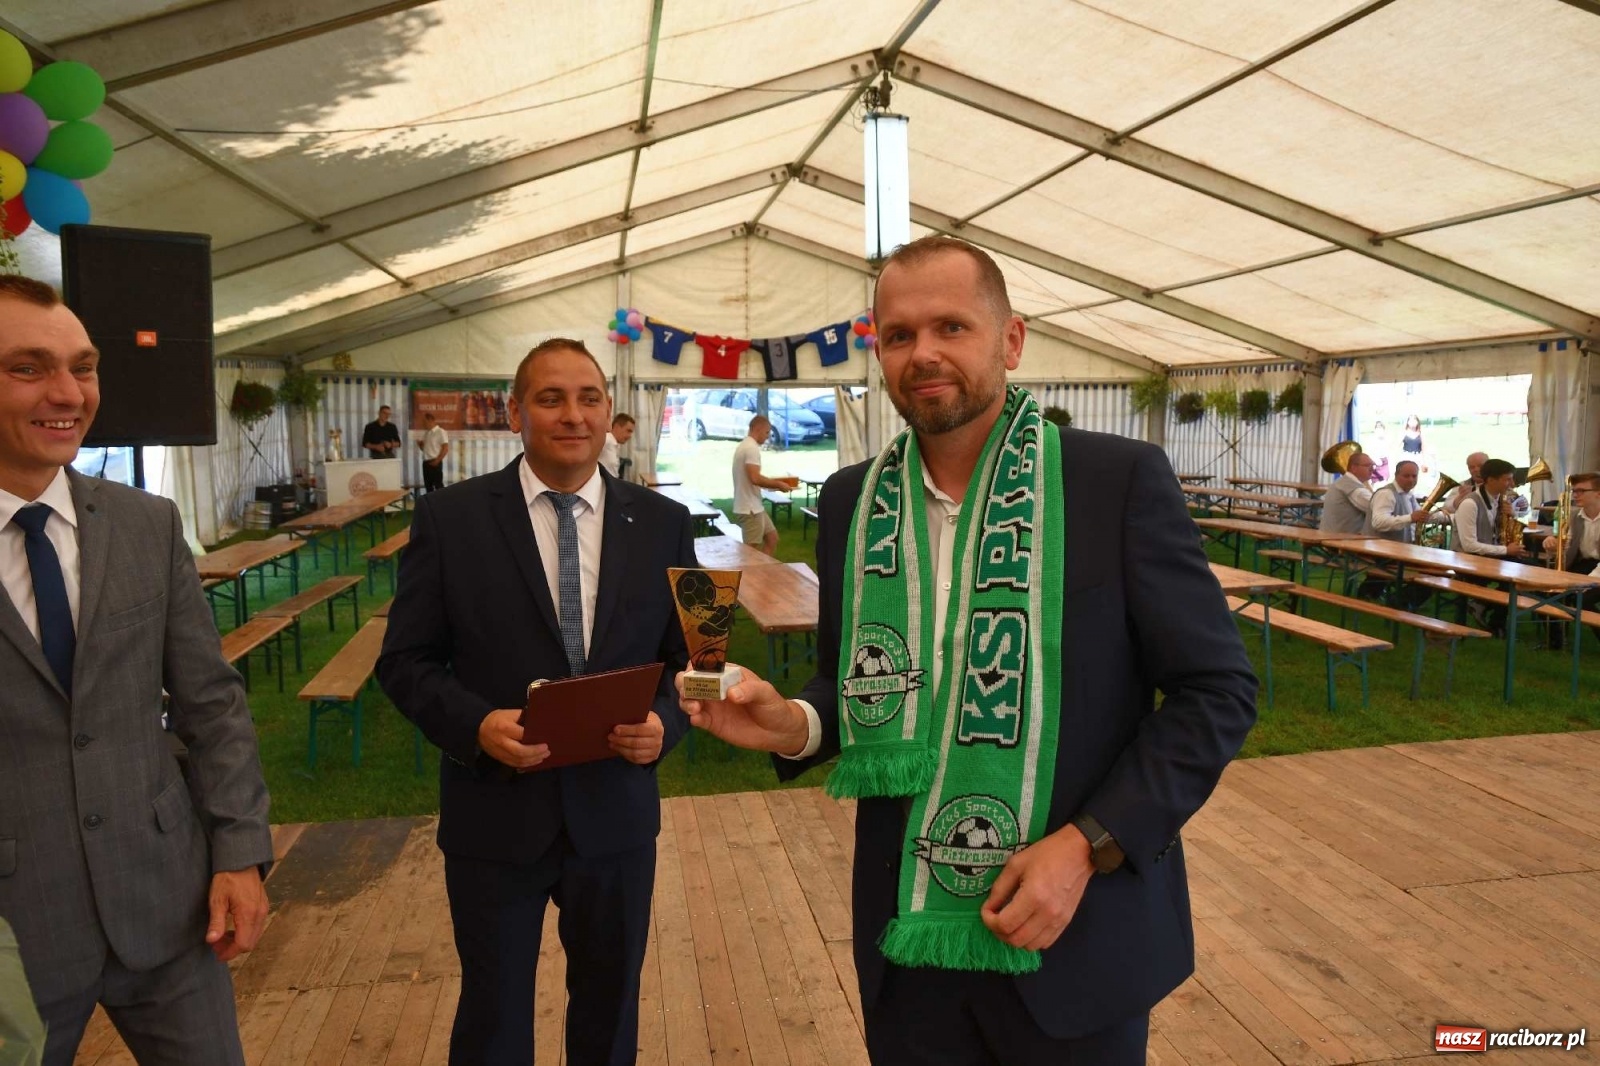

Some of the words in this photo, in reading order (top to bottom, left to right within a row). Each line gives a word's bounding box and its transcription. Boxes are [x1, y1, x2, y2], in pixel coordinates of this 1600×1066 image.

[663, 331, 673, 343] 7
[717, 344, 726, 357] 4
[775, 343, 783, 357] 3
[956, 608, 1028, 748] KS
[860, 705, 884, 720] 1926
[935, 806, 960, 839] Klub
[965, 801, 1013, 844] Sportowy
[953, 877, 984, 890] 1926
